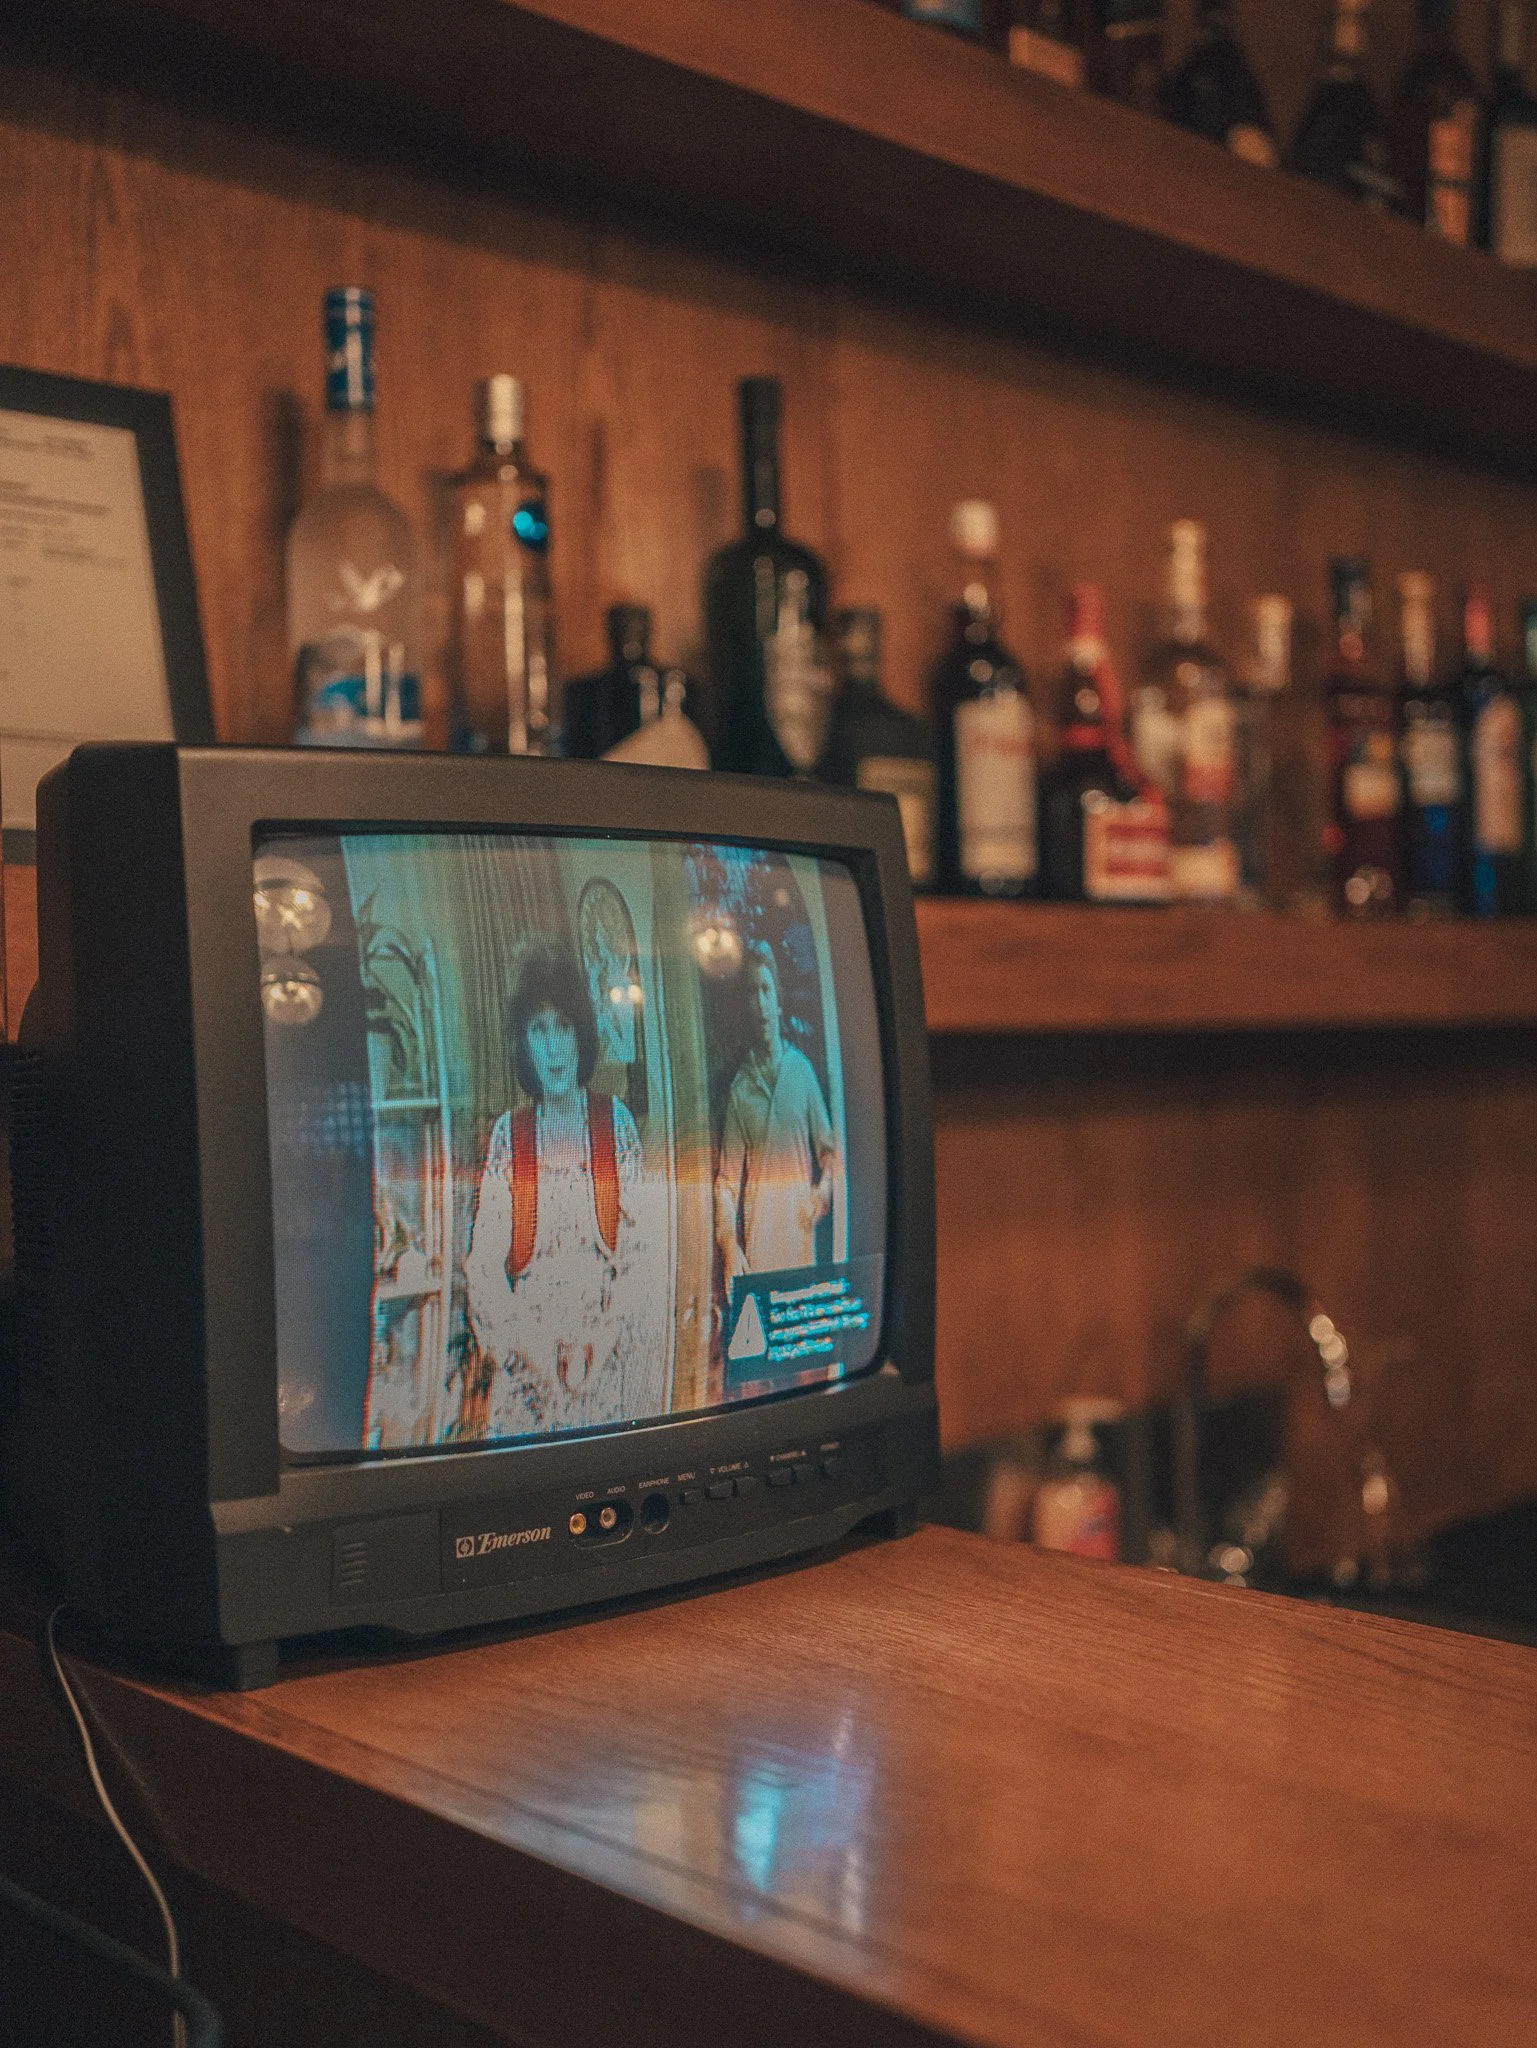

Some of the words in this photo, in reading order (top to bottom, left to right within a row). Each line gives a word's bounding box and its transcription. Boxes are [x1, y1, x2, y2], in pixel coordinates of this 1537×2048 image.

[718, 1463, 742, 1473] VOLUME
[677, 1473, 696, 1482] MENU
[638, 1478, 670, 1489] EARPHONE
[606, 1486, 626, 1495] AUDIO
[575, 1491, 594, 1500] VIDEO
[477, 1527, 552, 1555] Emerson
